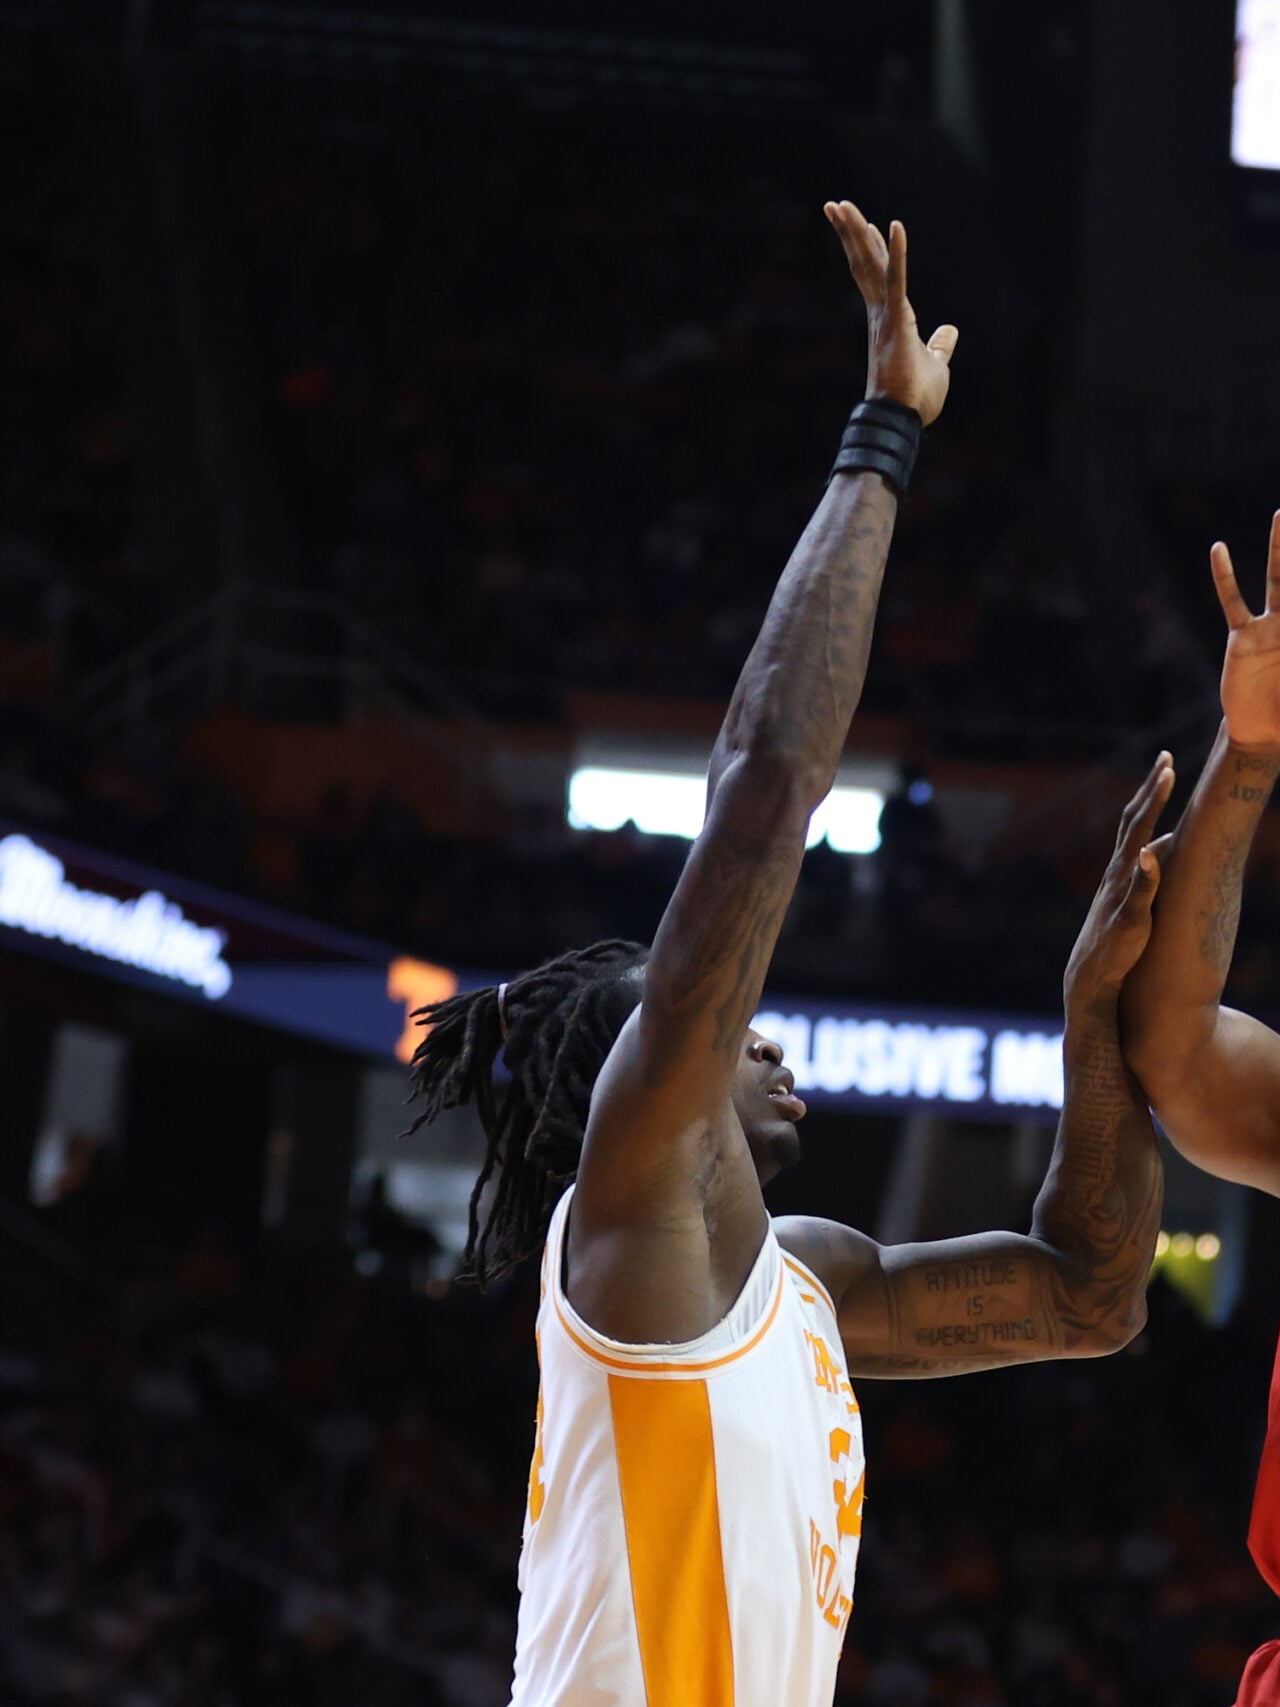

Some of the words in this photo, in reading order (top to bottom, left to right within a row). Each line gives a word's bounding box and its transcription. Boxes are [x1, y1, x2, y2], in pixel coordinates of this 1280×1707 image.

[926, 1261, 1018, 1292] ATTITUDE
[965, 1295, 985, 1317] IS
[914, 1318, 1038, 1348] EVERYTHING
